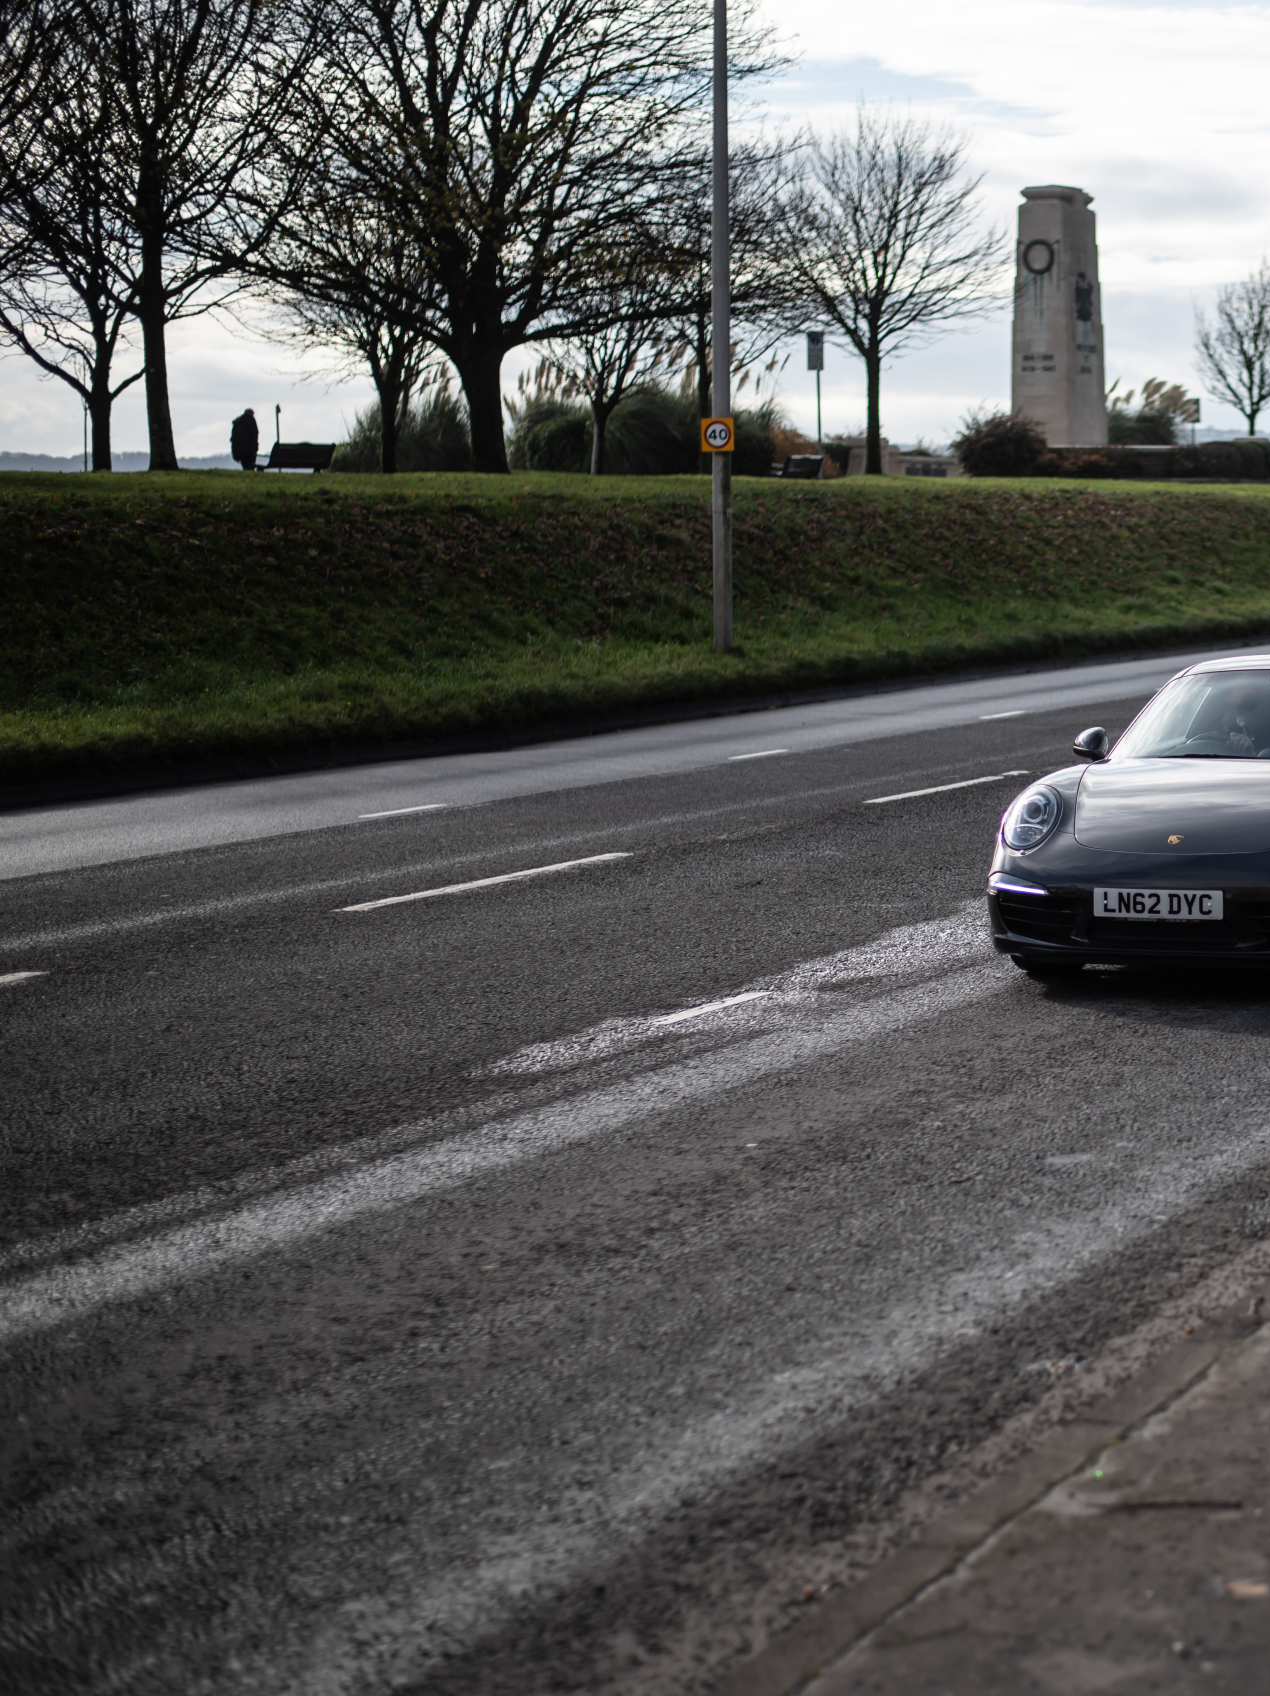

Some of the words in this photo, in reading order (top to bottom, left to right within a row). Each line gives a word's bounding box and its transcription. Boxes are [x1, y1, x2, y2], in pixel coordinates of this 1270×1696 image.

[708, 428, 728, 441] 40
[1103, 891, 1161, 914] LN62
[1168, 893, 1213, 915] DYC
